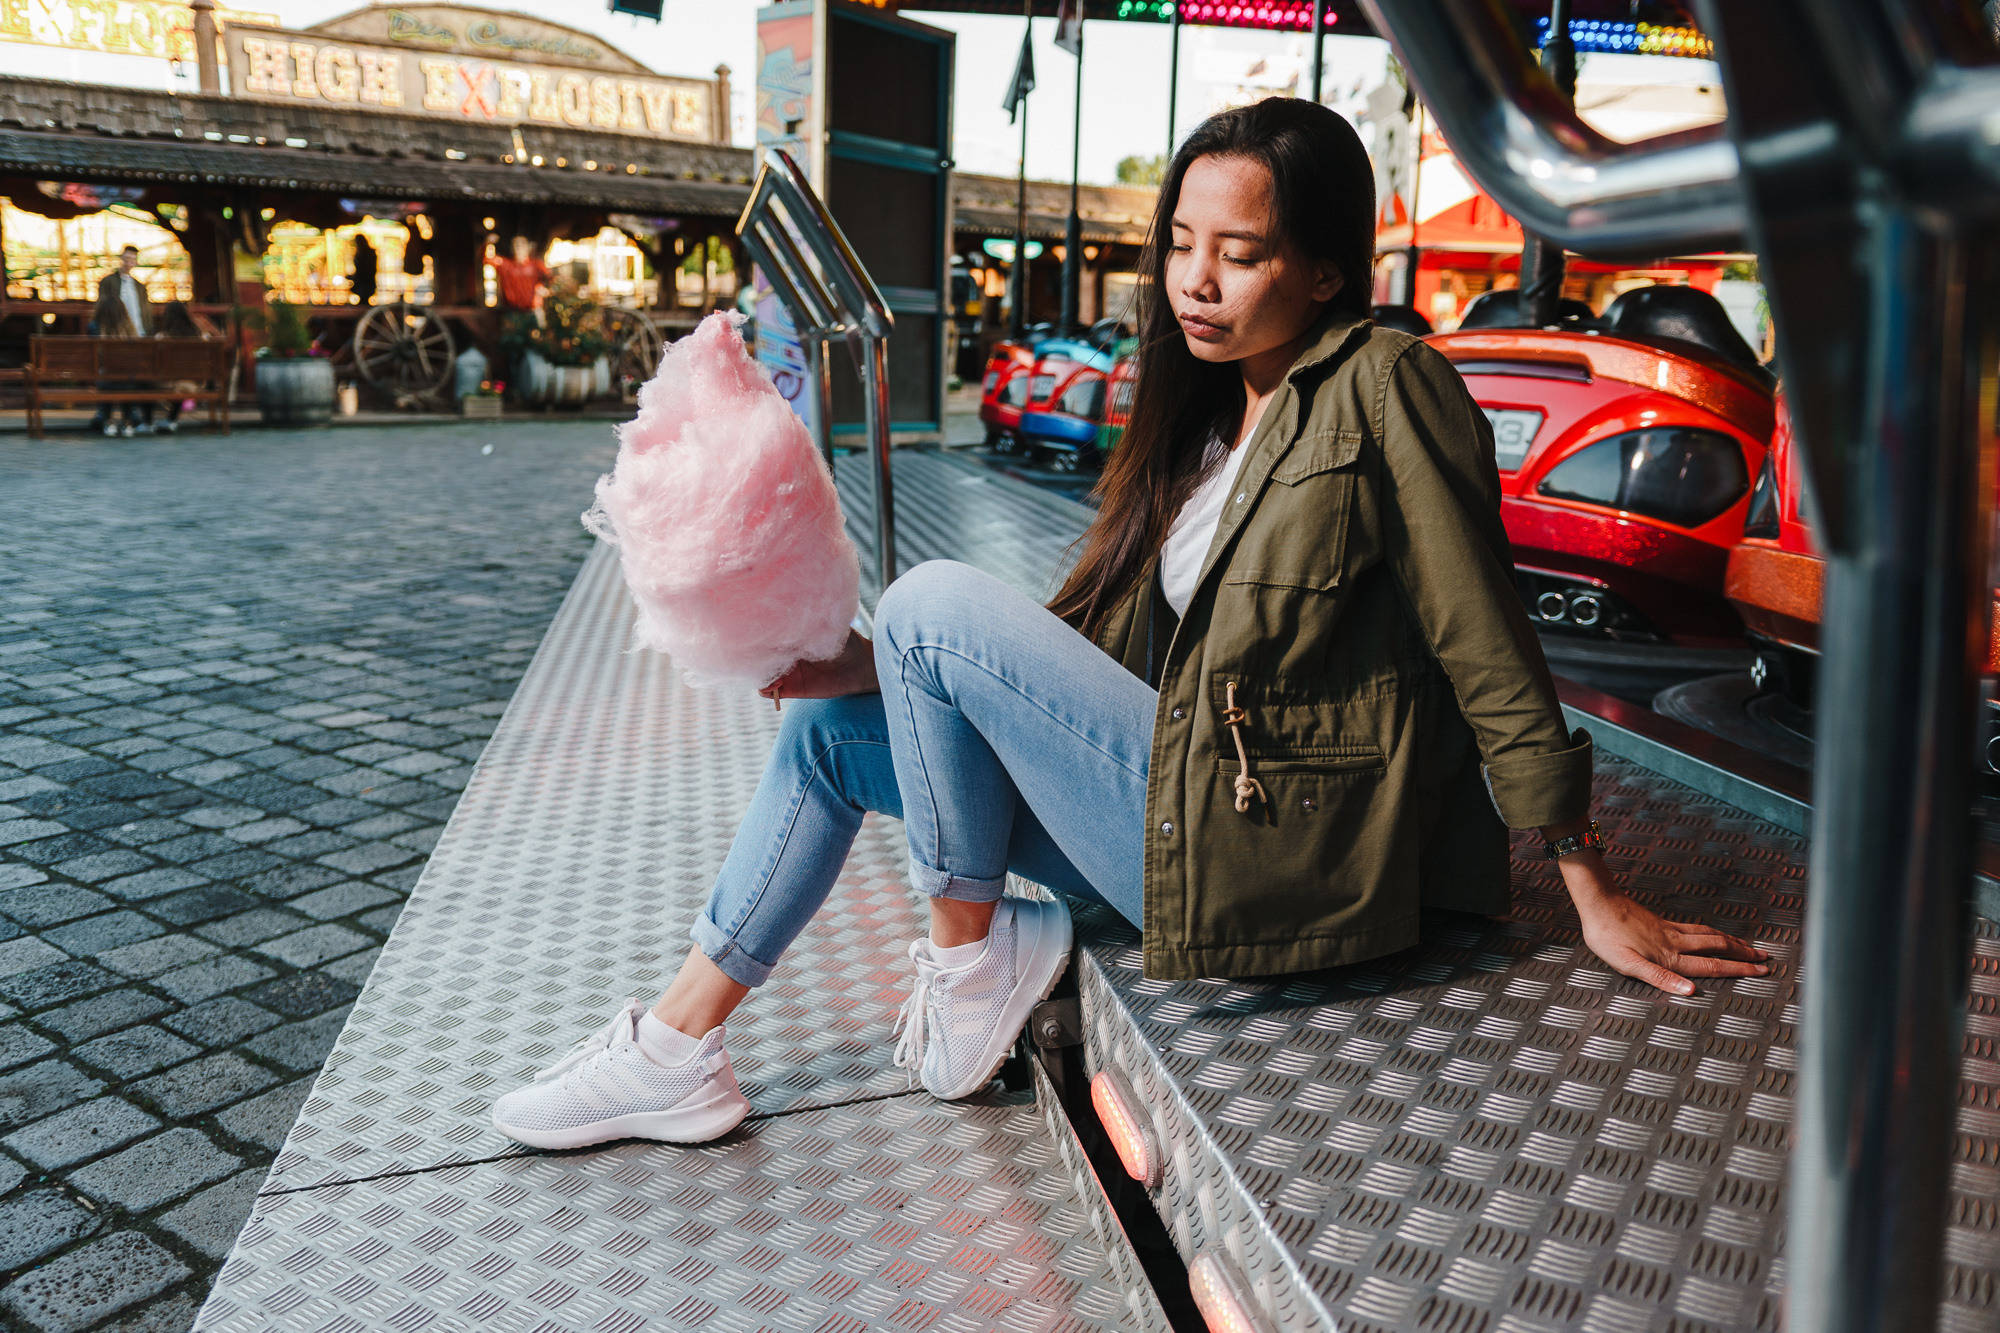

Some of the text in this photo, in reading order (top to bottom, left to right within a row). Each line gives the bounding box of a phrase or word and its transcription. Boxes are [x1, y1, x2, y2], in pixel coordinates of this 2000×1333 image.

[0, 0, 193, 54] EXPLOS
[243, 37, 405, 107] HIGH
[420, 58, 703, 135] EXPLOSIVE
[1490, 419, 1524, 446] 3
